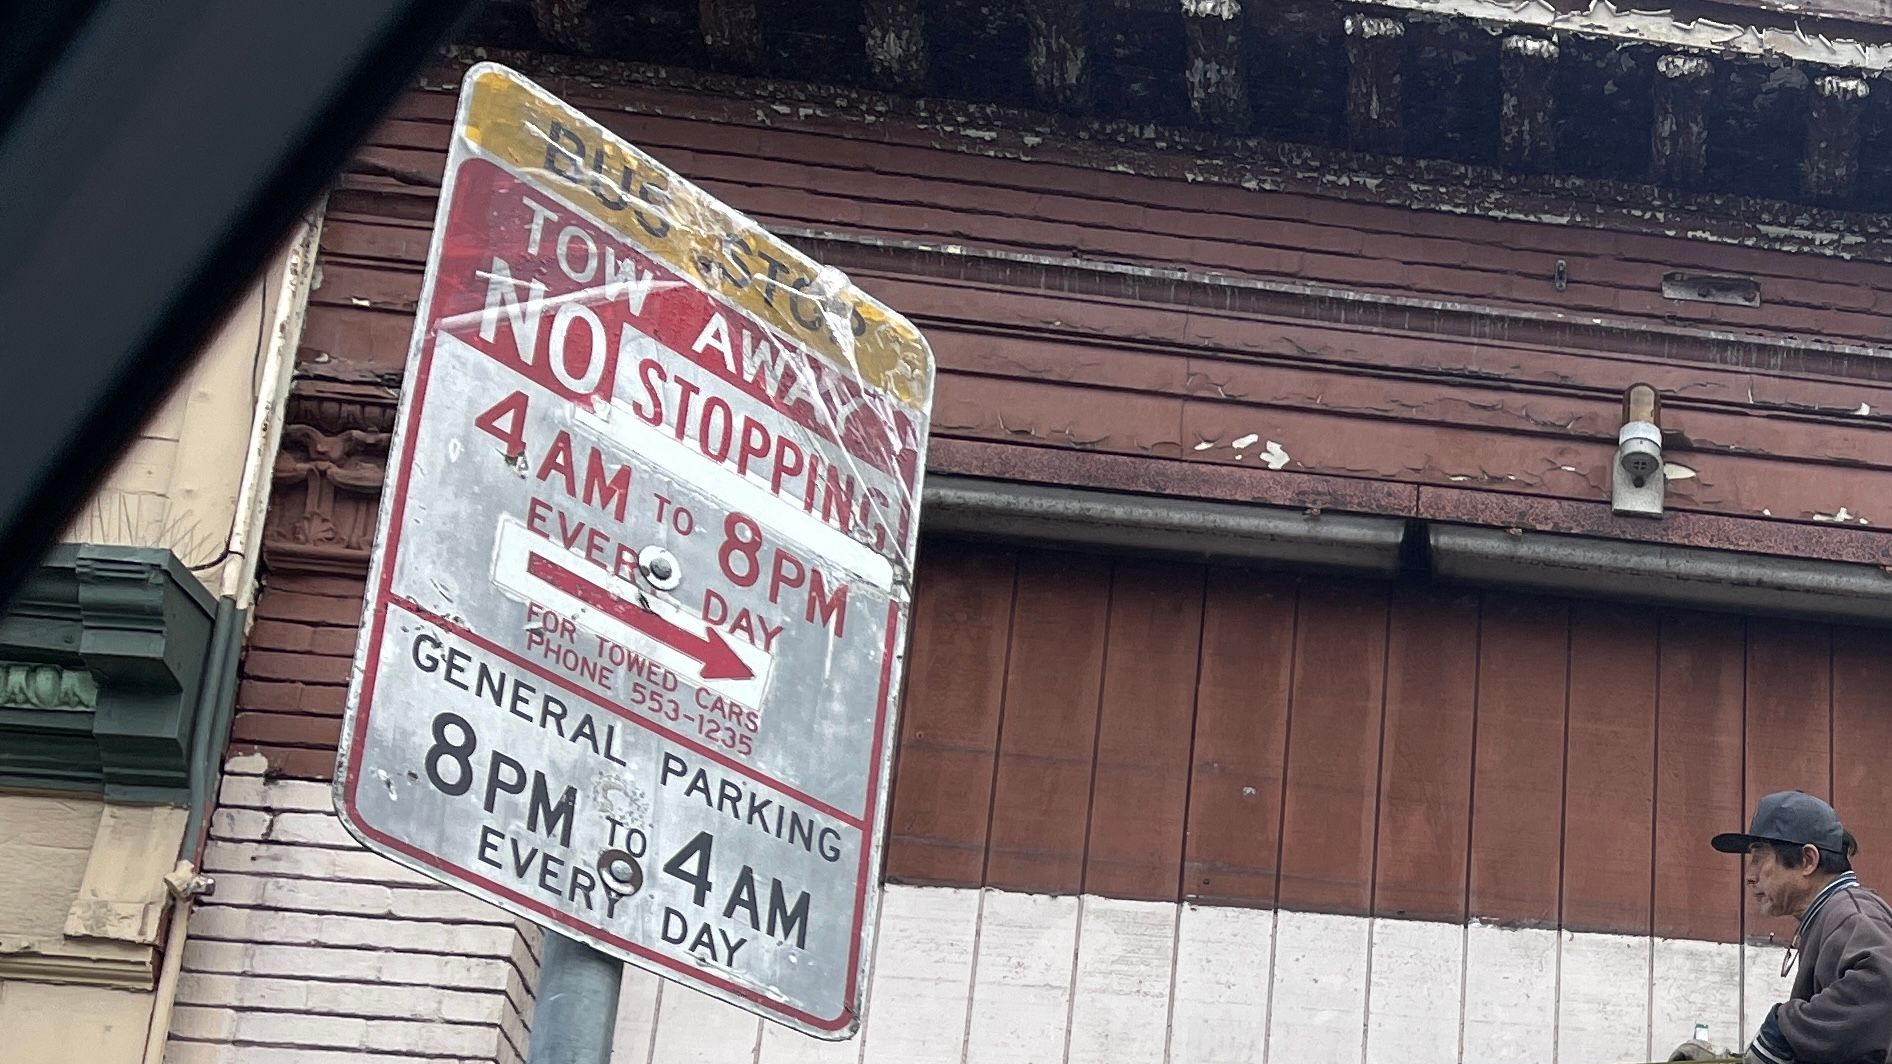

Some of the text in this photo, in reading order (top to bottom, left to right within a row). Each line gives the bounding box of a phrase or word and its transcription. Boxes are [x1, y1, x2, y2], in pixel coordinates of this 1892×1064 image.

[544, 121, 670, 238] BUS
[520, 195, 864, 440] TOW AWAY
[477, 257, 890, 551] NO STOPPING
[526, 497, 785, 653] EVER DAY
[653, 492, 695, 538] TO
[527, 602, 760, 735] FOR TOWED CARS
[527, 630, 754, 757] PHONE 553-1235
[411, 632, 842, 864] GENERAL PARKING
[478, 825, 748, 969] EVERY DAY
[606, 819, 648, 860] TO
